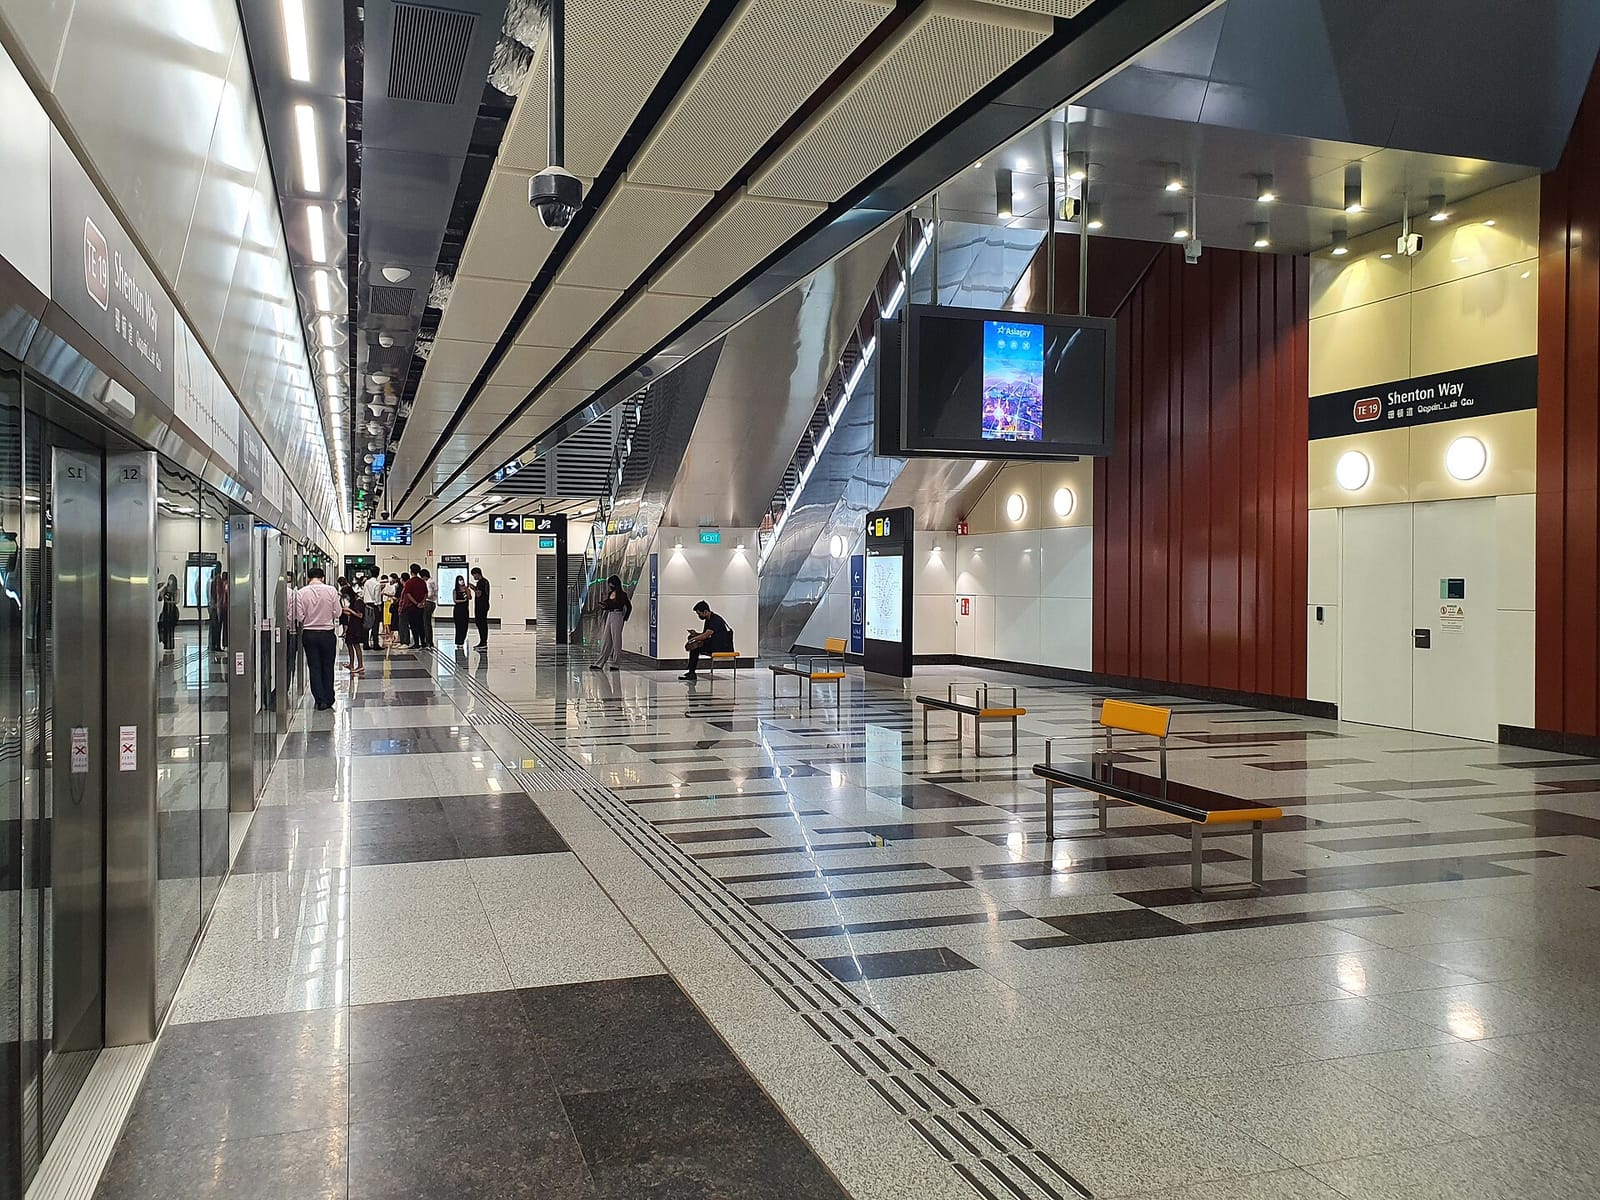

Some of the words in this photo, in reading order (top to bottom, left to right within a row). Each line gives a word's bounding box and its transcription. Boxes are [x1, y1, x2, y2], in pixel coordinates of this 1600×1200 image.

[86, 239, 97, 279] TE
[97, 255, 107, 289] 19
[113, 250, 145, 319] Shenton
[144, 291, 159, 343] Way
[1387, 388, 1435, 406] Shenton
[1438, 382, 1464, 397] Way
[1357, 406, 1367, 415] TE
[1368, 404, 1378, 414] 19
[123, 468, 138, 480] 12
